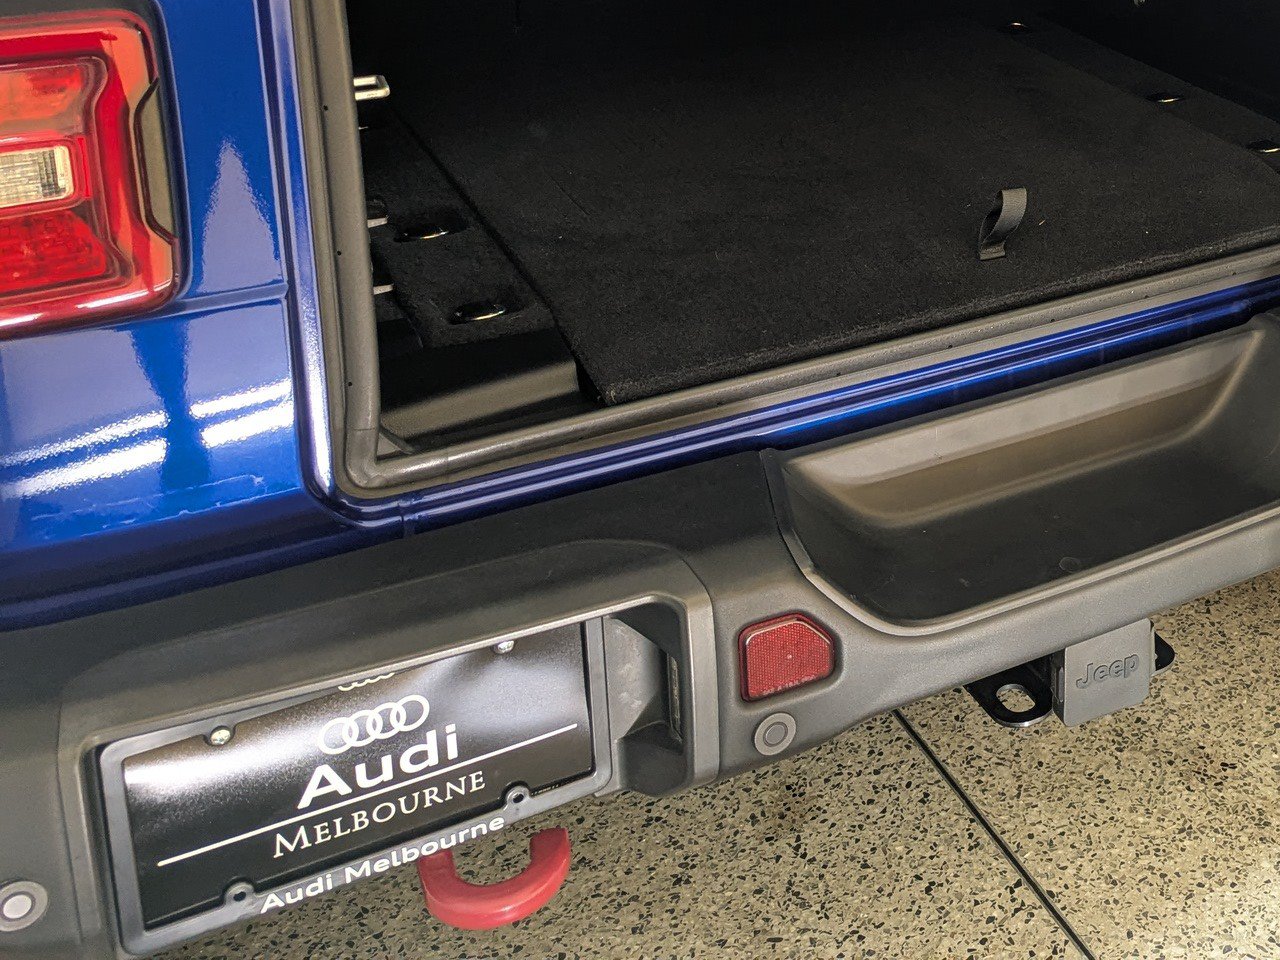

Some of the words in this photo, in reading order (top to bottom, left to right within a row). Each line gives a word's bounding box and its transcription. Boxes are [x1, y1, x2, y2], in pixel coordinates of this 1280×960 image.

[1075, 653, 1140, 690] Jeep
[296, 723, 459, 811] Audi
[272, 769, 488, 860] MELBOURNE
[259, 875, 336, 915] Audi
[344, 815, 508, 883] Melbourne
